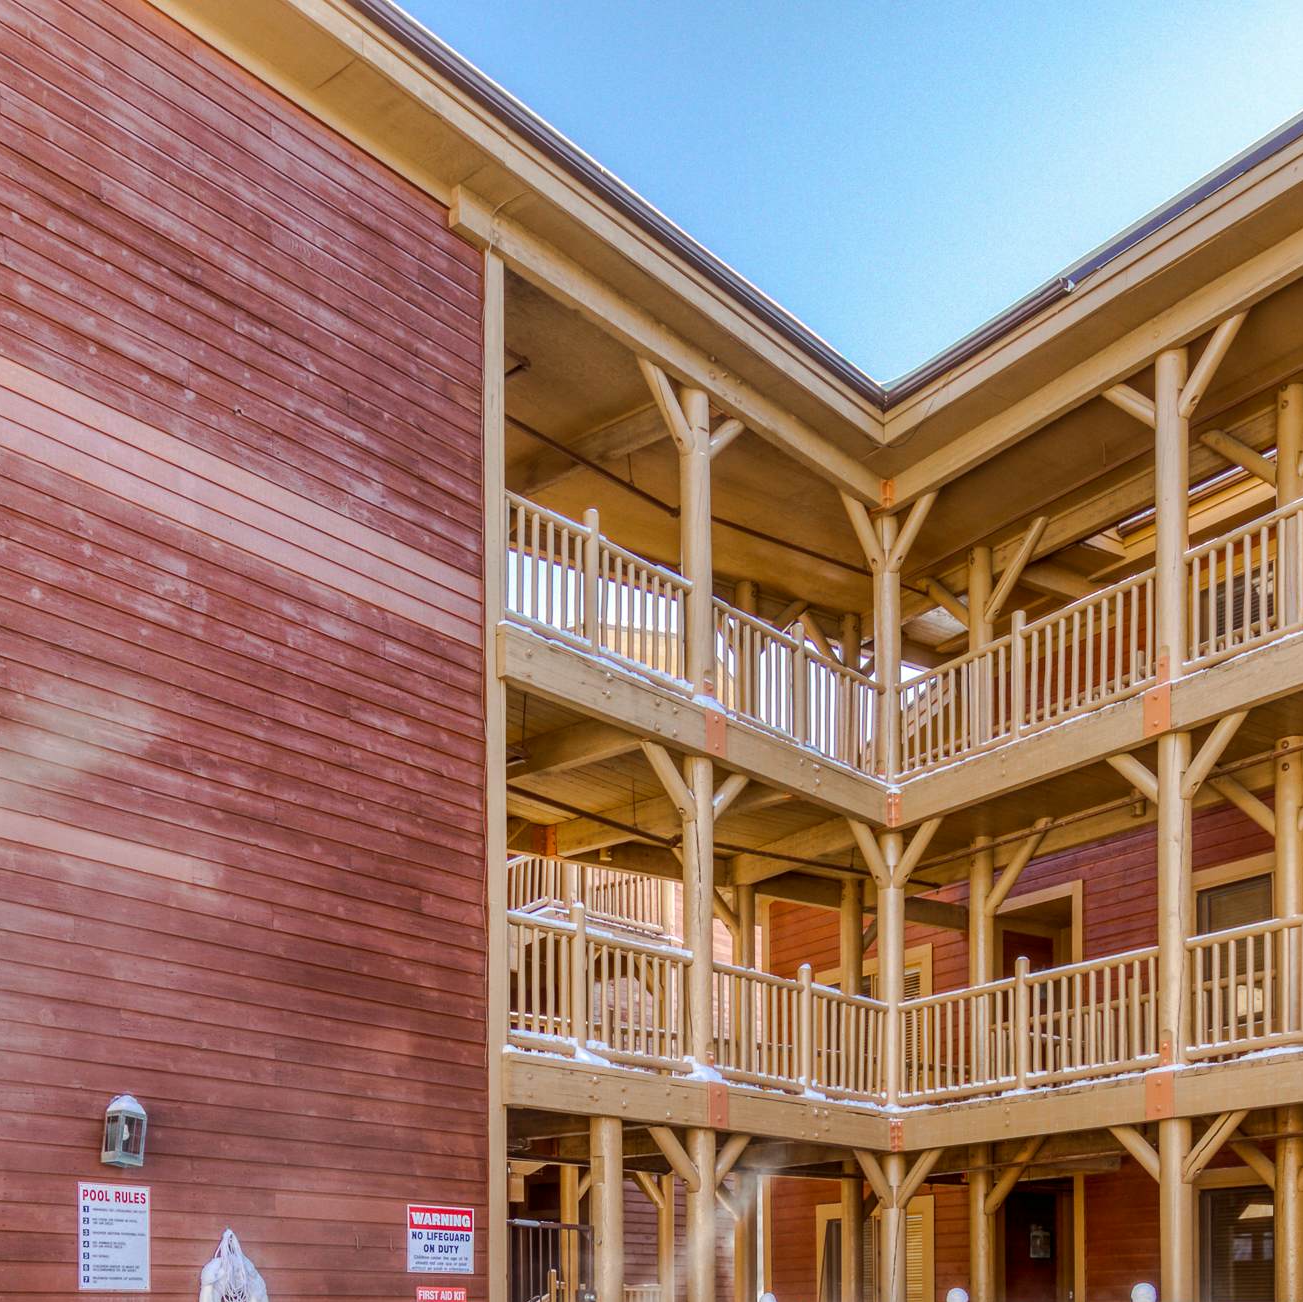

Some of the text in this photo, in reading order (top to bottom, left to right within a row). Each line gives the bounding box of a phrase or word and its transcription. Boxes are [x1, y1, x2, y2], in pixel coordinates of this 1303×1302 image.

[82, 1189, 146, 1204] POOL RULES
[410, 1211, 471, 1228] WARNING
[411, 1231, 471, 1242] NO LIFEGUARD
[423, 1244, 459, 1254] ON DUTY
[418, 1290, 466, 1301] FIRST AID KIT
